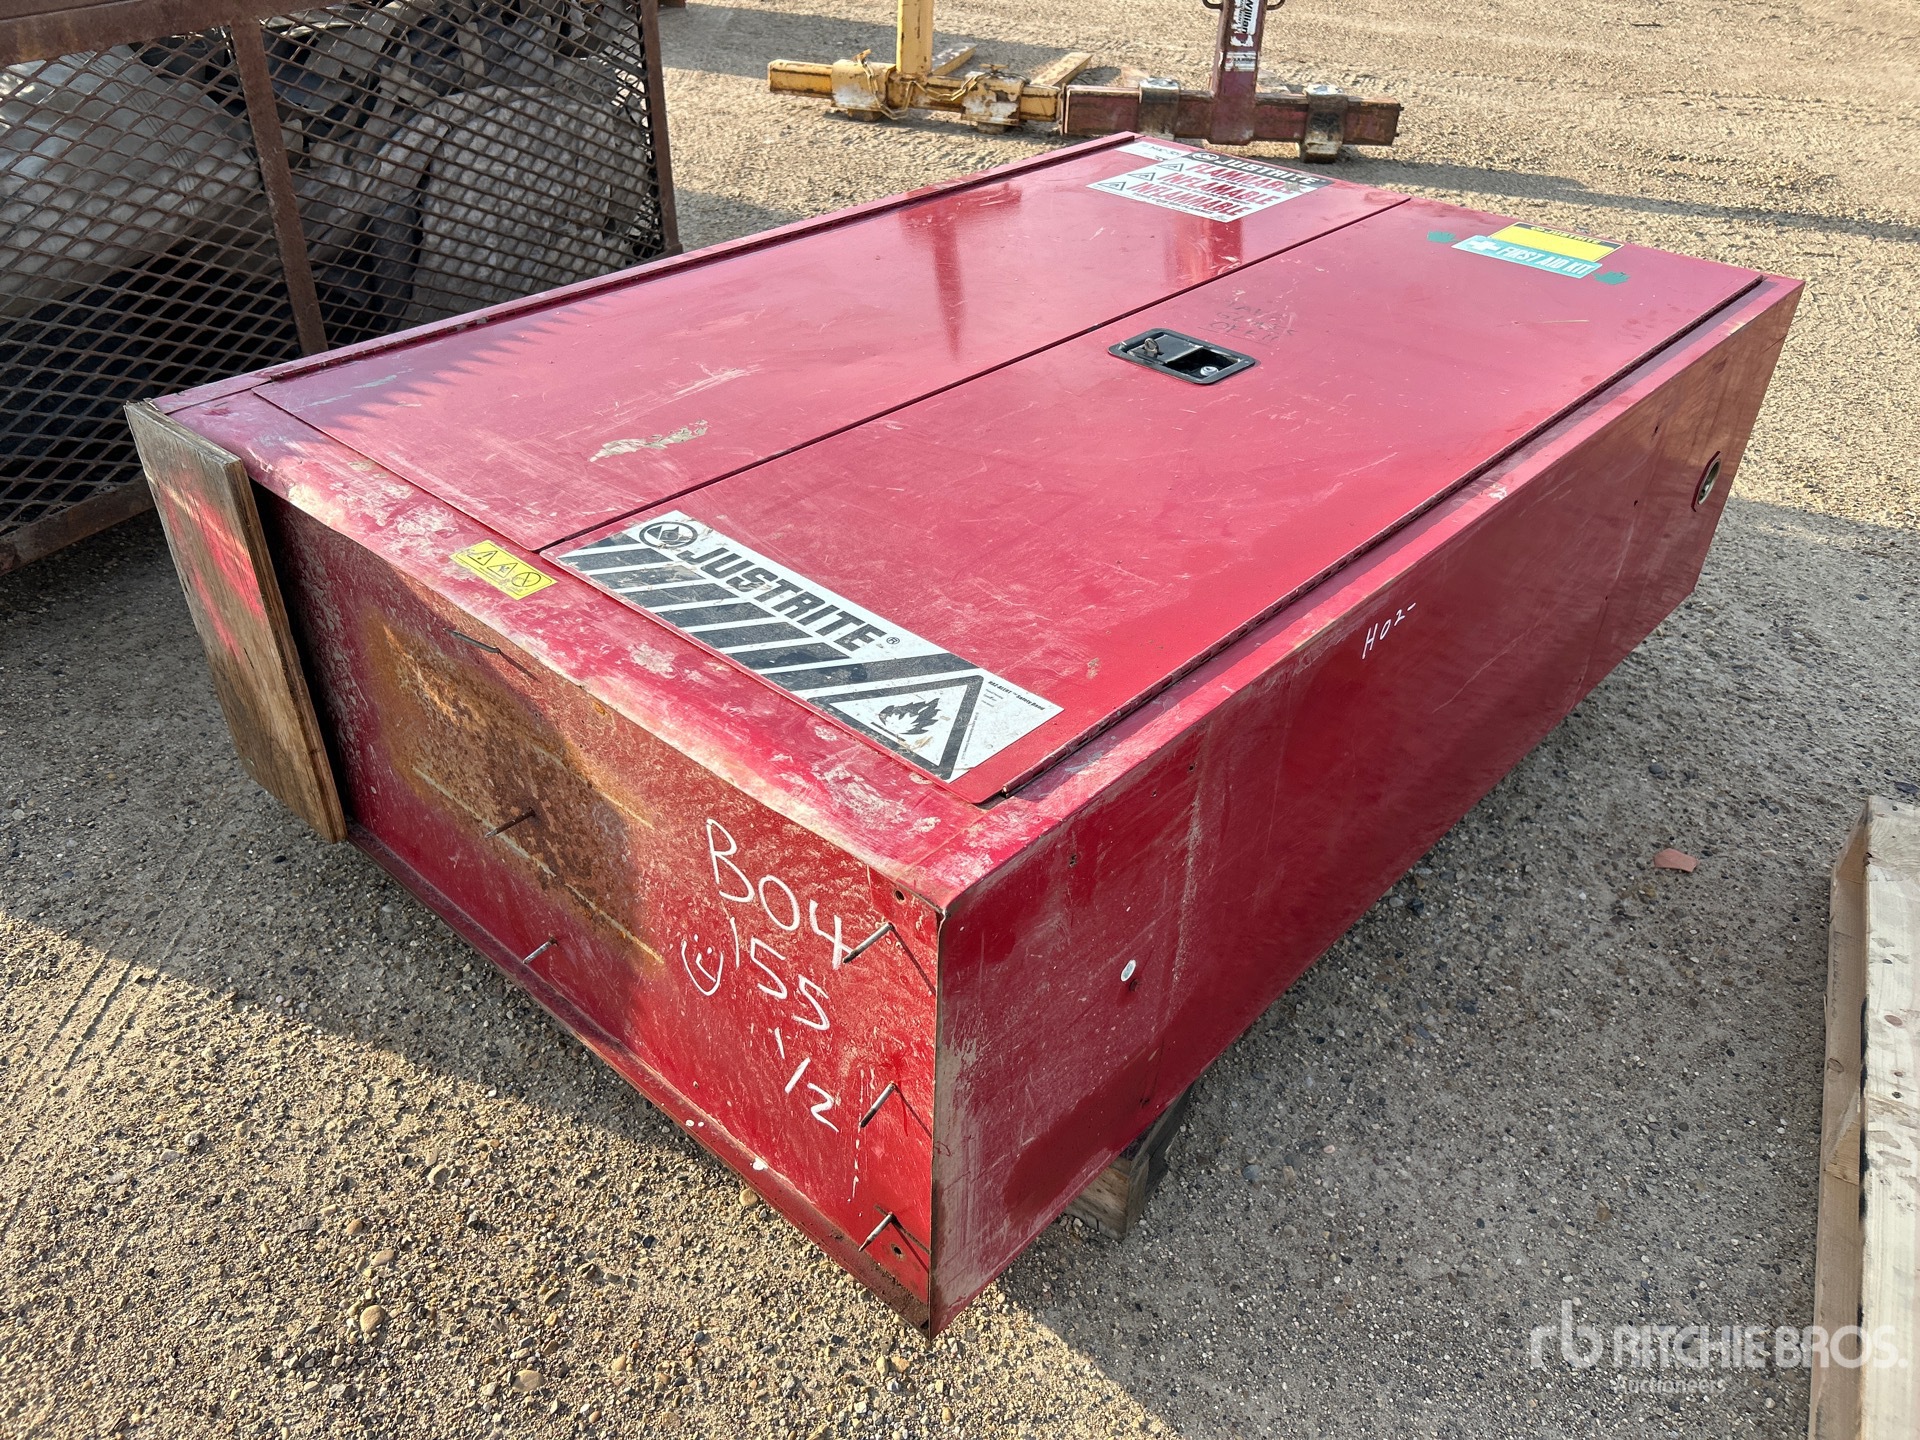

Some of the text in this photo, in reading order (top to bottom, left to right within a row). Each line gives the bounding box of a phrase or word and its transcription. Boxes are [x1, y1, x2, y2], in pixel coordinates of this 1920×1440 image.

[1214, 158, 1320, 185] JUSTRITE
[1126, 182, 1252, 216] INFLAMMABLE
[1157, 172, 1281, 205] INFLAMABLE
[1496, 246, 1595, 275] FIRST AID KIT
[676, 547, 888, 652] JUSTRITE
